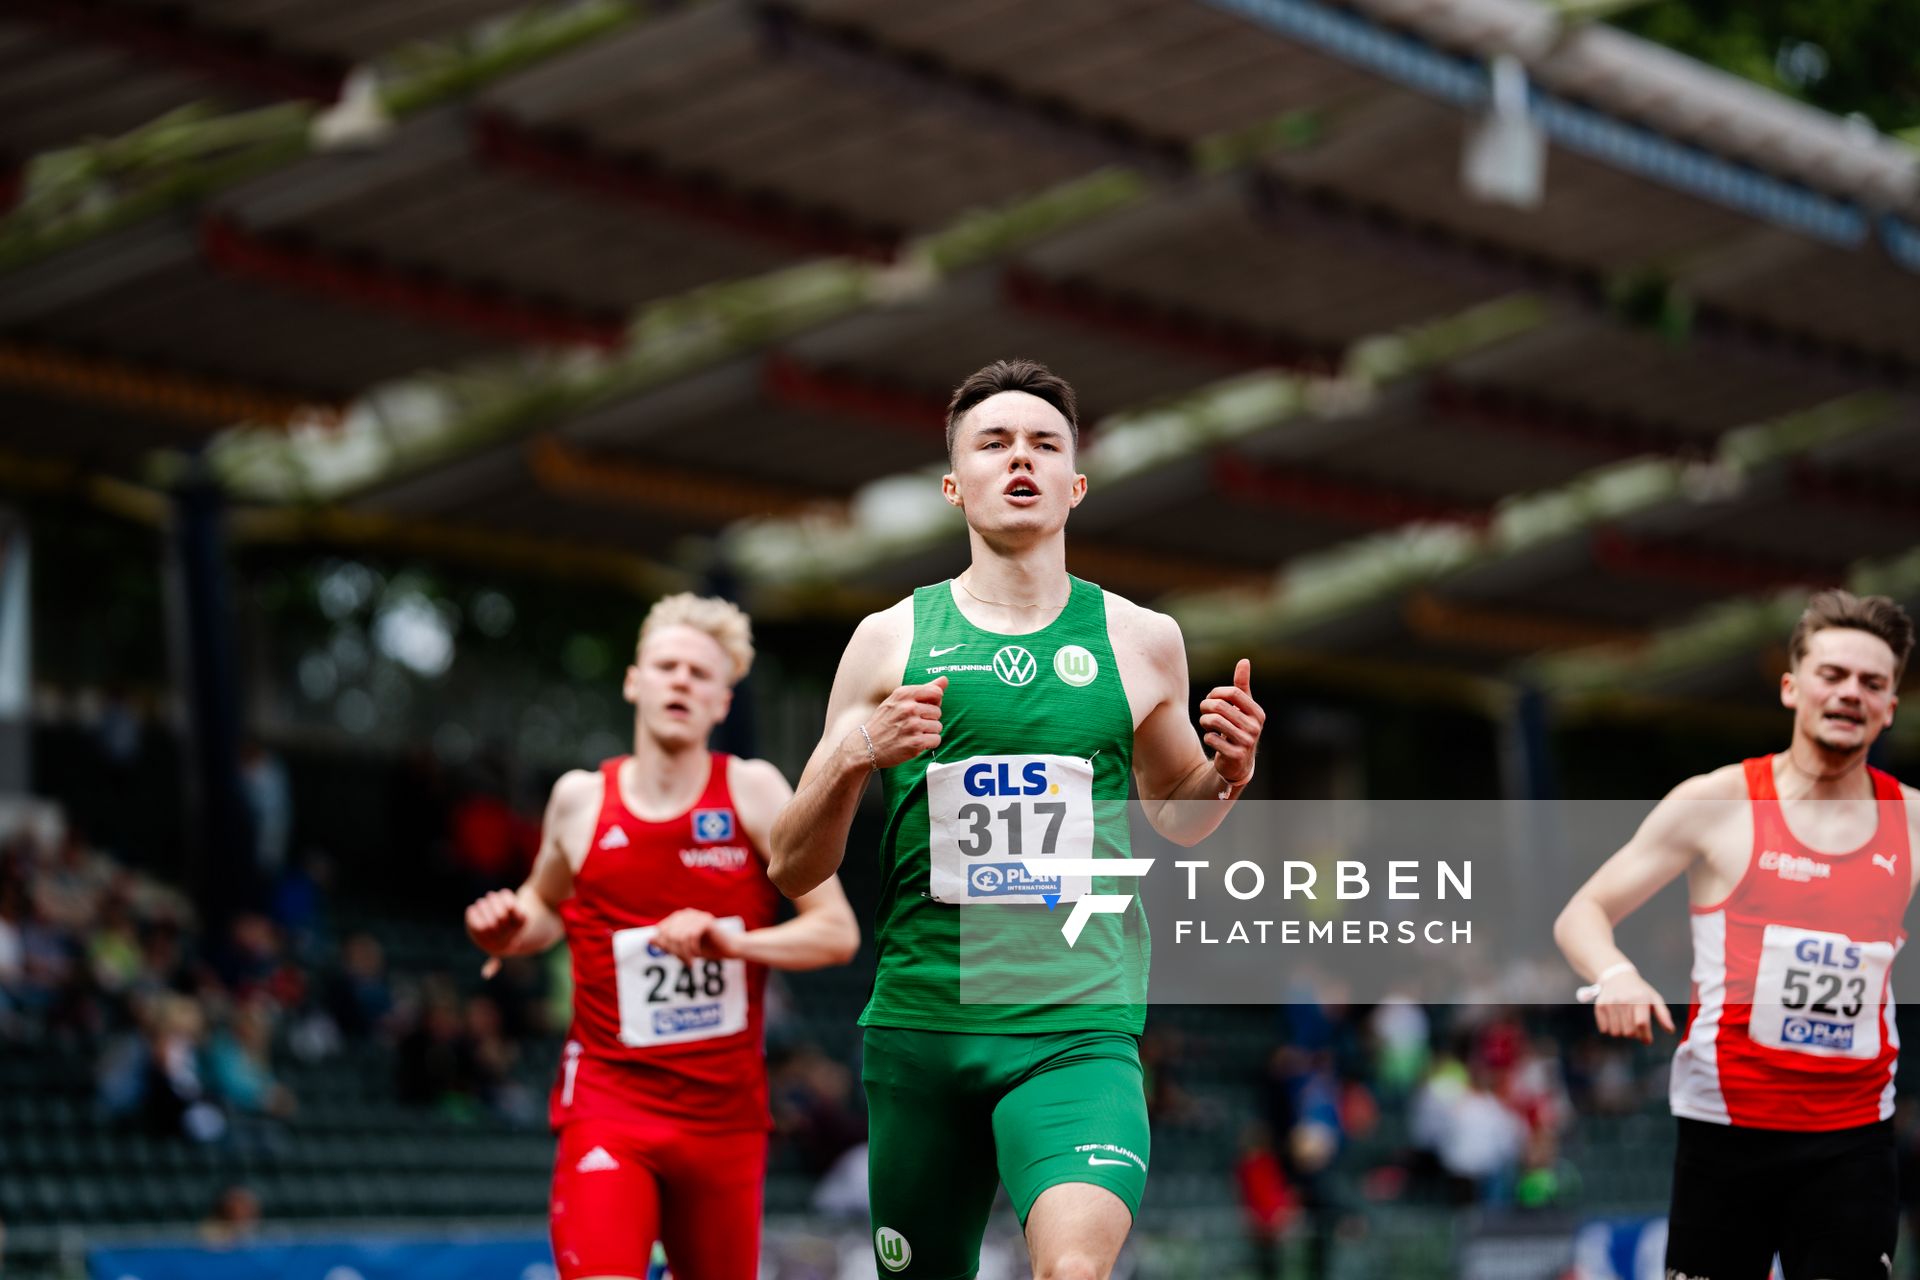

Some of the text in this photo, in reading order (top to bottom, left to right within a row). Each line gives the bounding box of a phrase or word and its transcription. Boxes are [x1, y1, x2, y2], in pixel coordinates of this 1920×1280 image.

[958, 801, 1067, 857] 317
[645, 959, 725, 1003] 248
[1781, 968, 1867, 1018] 523
